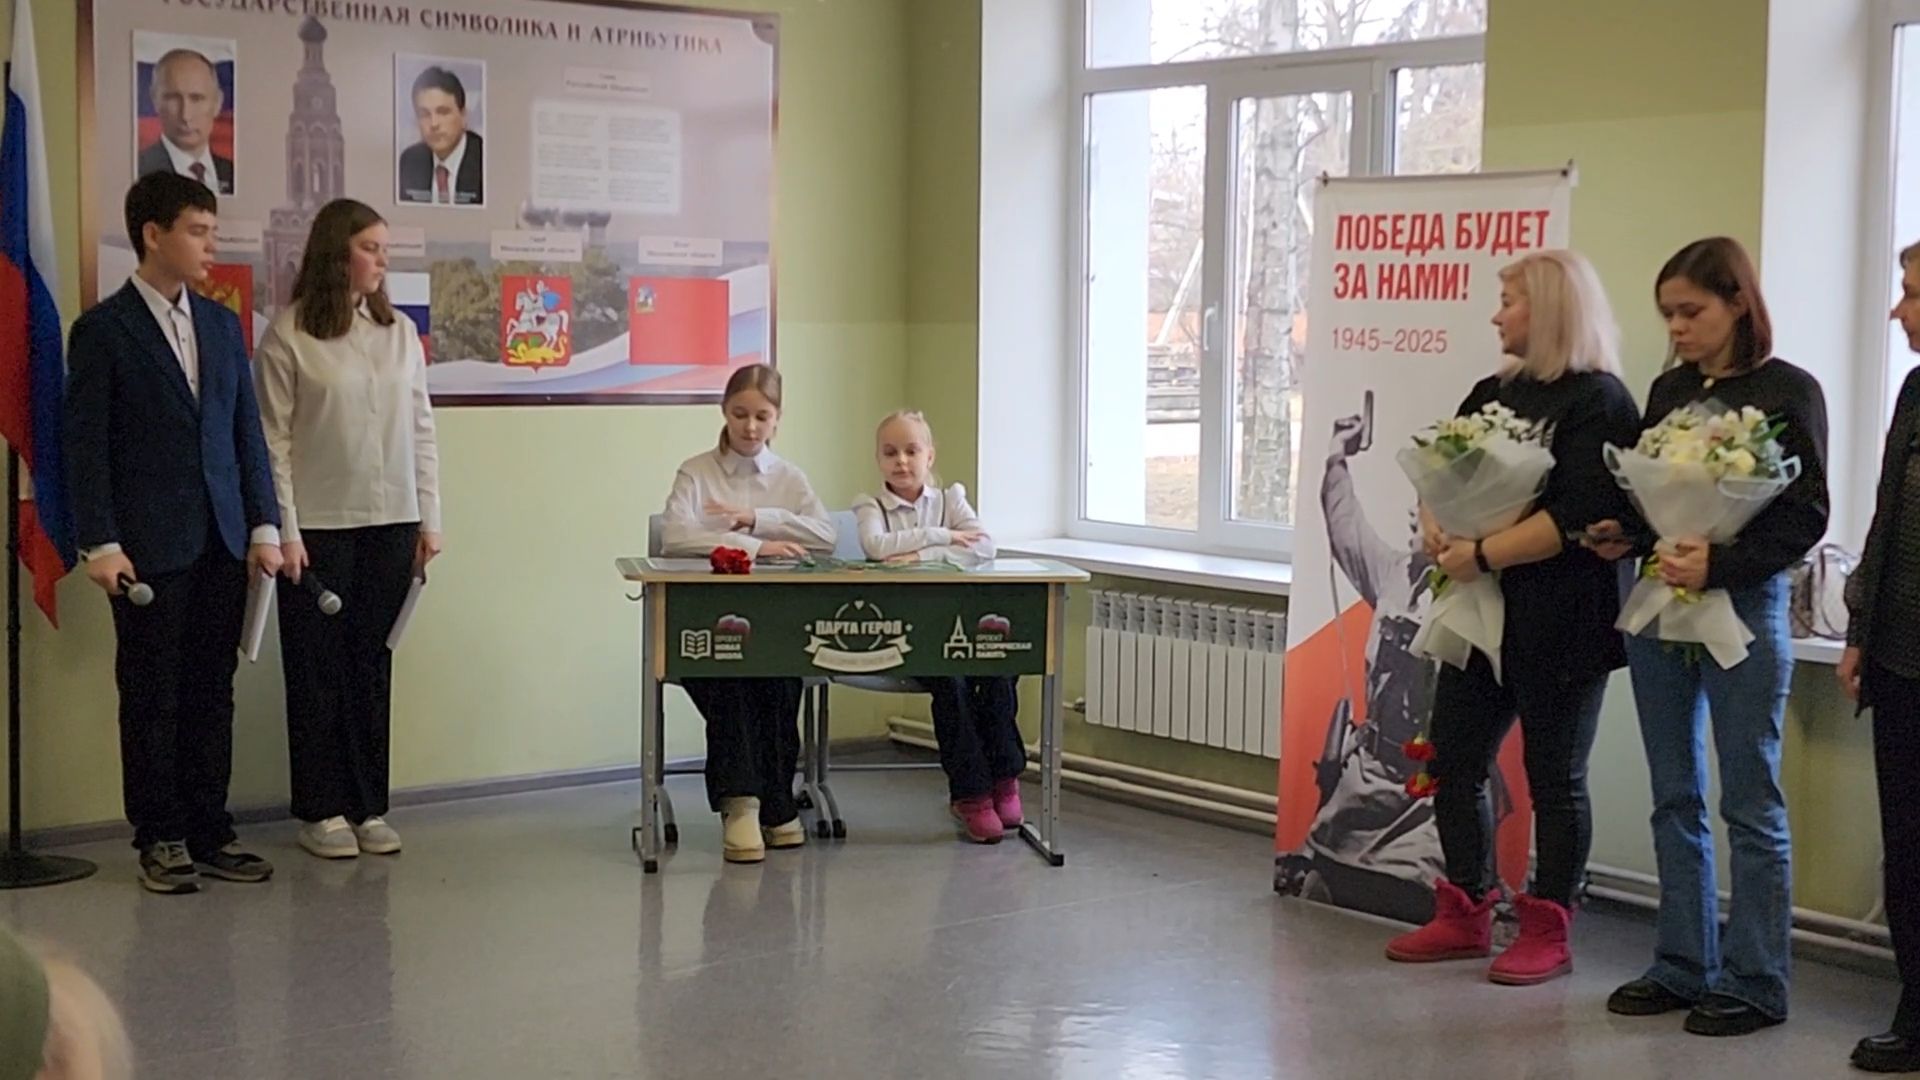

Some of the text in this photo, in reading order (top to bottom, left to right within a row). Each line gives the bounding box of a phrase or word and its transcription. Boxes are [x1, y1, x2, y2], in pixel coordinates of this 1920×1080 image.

[419, 8, 557, 40] СИМВОЛИКА
[567, 22, 580, 42] И
[591, 26, 722, 53] АТРИБУТИКА
[1335, 210, 1550, 257] ПОБЕДА БУДЕТ
[1334, 263, 1469, 300] ЗА НАМИ!
[1332, 327, 1448, 354] 1945–2025
[815, 620, 902, 635] ПАРТА ГЕРОЯ
